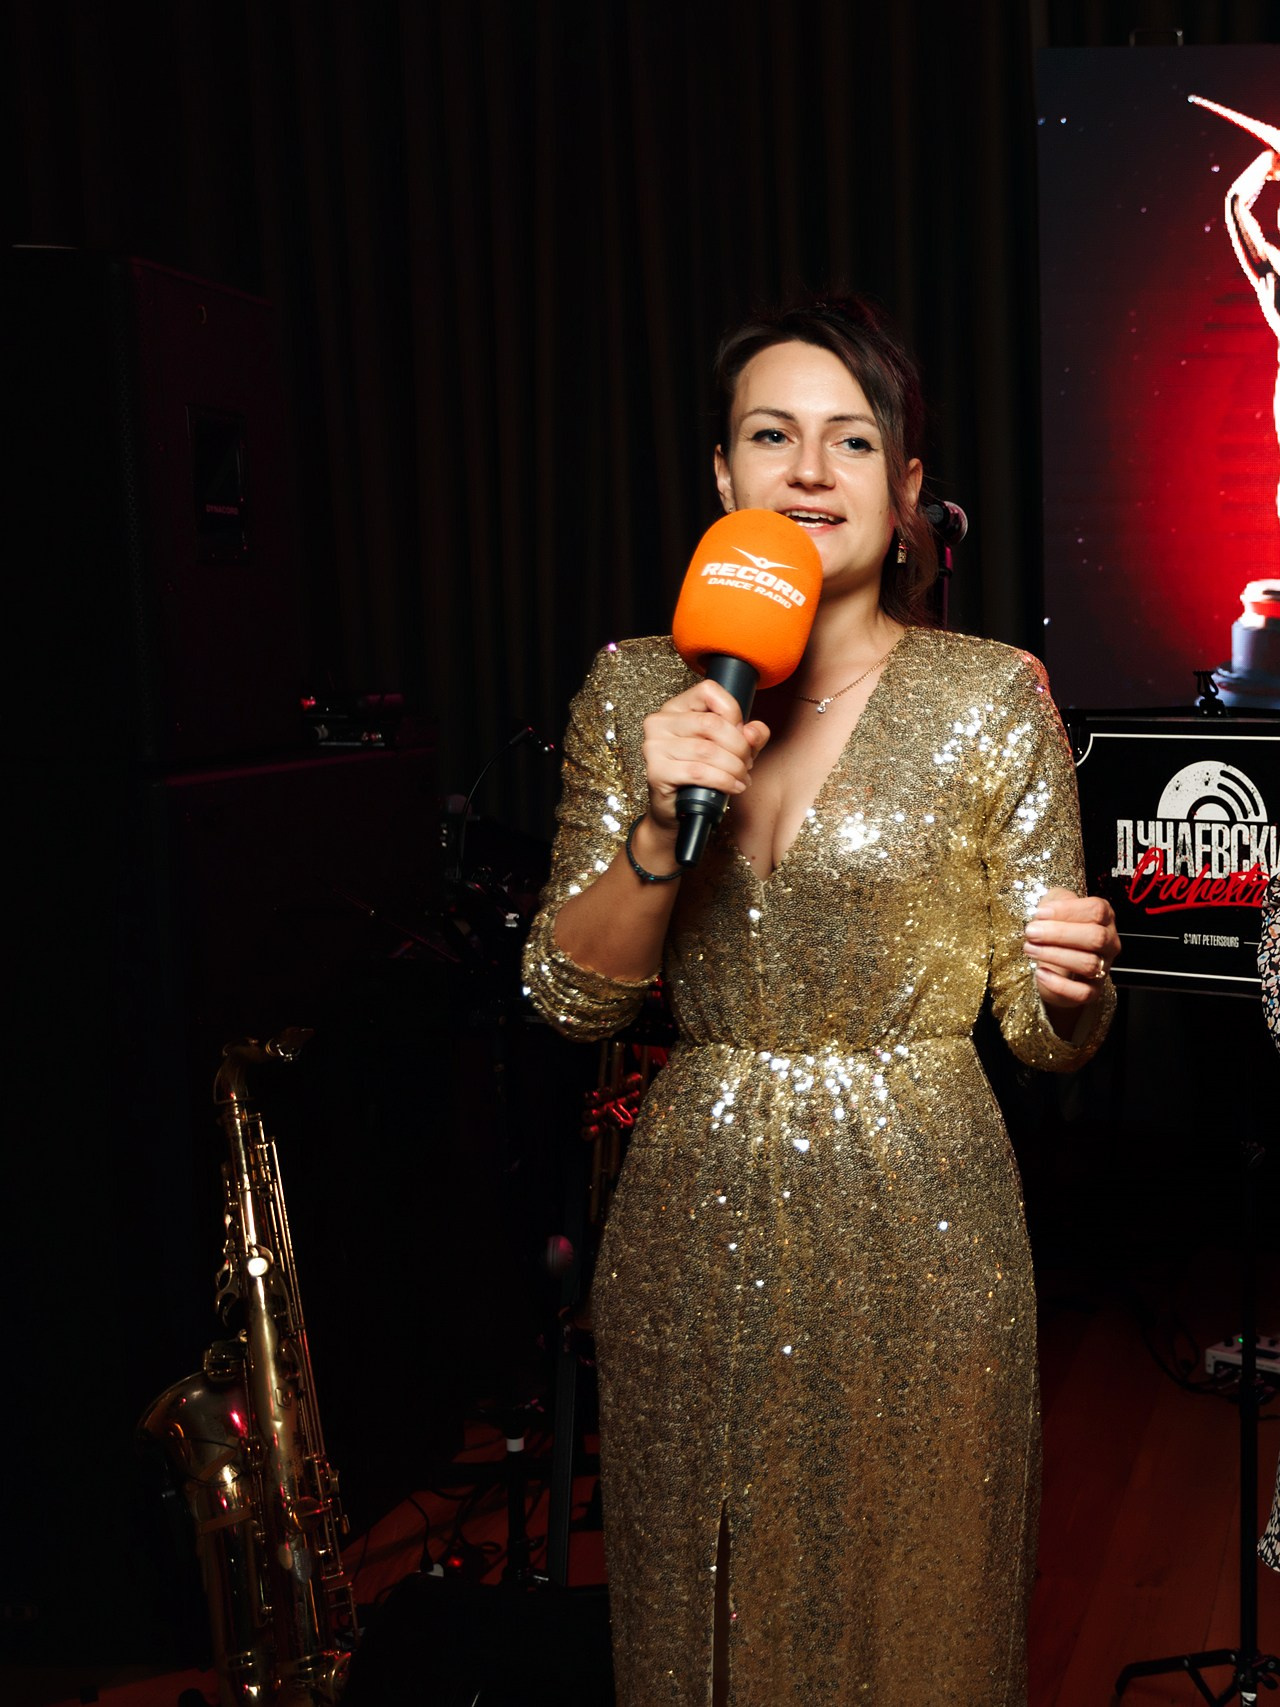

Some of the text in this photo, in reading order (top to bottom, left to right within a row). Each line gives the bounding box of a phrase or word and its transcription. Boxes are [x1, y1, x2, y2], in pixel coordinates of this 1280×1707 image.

[701, 562, 807, 607] RECORD
[707, 577, 793, 608] DANCE RADIO
[1128, 847, 1270, 907] Orchestr
[1202, 934, 1239, 948] PETERSBURG
